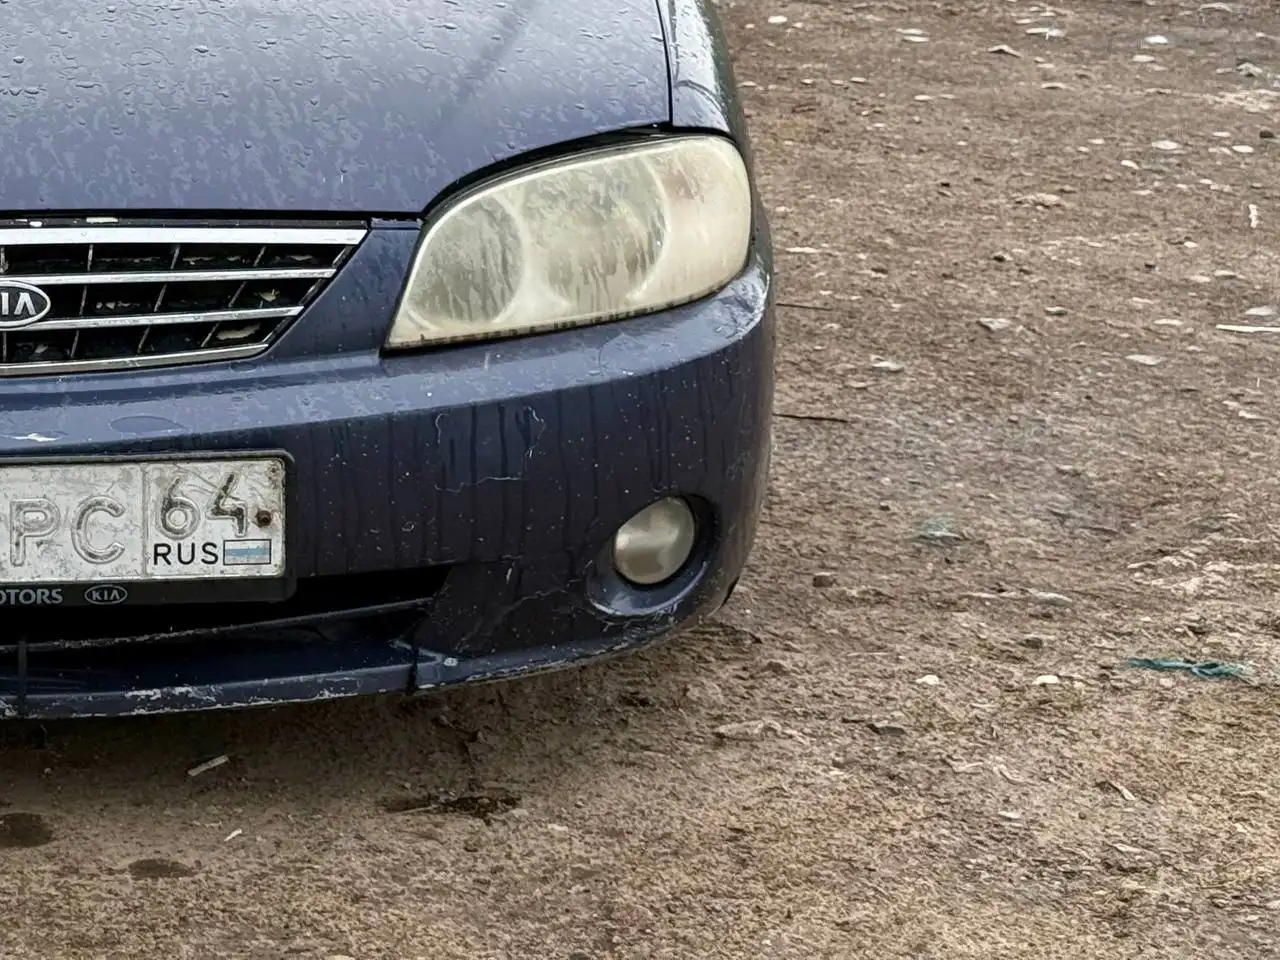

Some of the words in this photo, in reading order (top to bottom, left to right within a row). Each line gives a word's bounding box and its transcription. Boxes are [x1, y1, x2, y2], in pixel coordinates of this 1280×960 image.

[157, 472, 249, 540] 64
[152, 541, 220, 567] RUS
[91, 590, 122, 601] KIA
